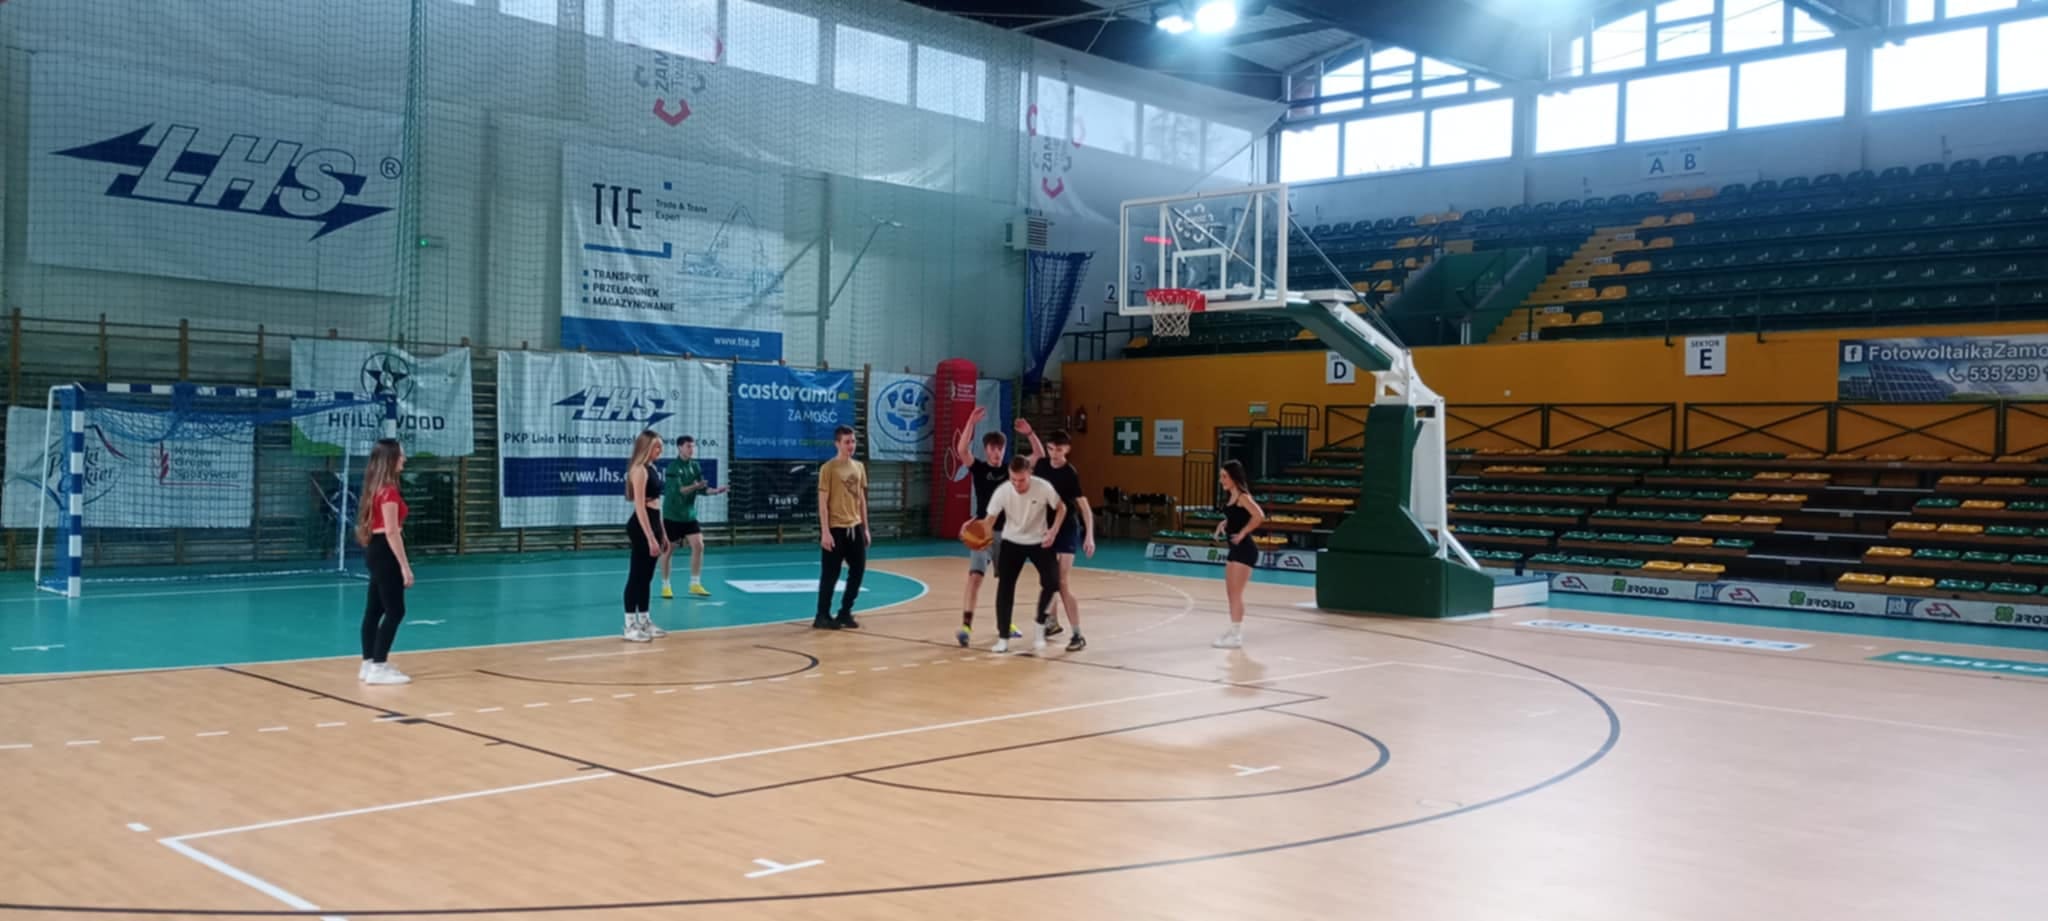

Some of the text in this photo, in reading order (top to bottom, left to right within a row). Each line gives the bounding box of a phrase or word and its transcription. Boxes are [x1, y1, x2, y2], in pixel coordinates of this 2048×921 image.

[131, 123, 357, 217] LHS
[1649, 157, 1664, 175] A
[1684, 153, 1697, 171] B
[592, 183, 642, 230] TTE
[593, 269, 649, 283] TRANSPORT
[1107, 284, 1116, 300] 2
[1700, 349, 1713, 370] E
[1334, 361, 1347, 379] D
[1970, 367, 2000, 382] 535
[2007, 366, 2038, 381] 299
[738, 381, 837, 403] castorama
[582, 385, 660, 420] LHS
[787, 408, 838, 424] ZAMOŚĆ
[504, 432, 528, 443] PKP
